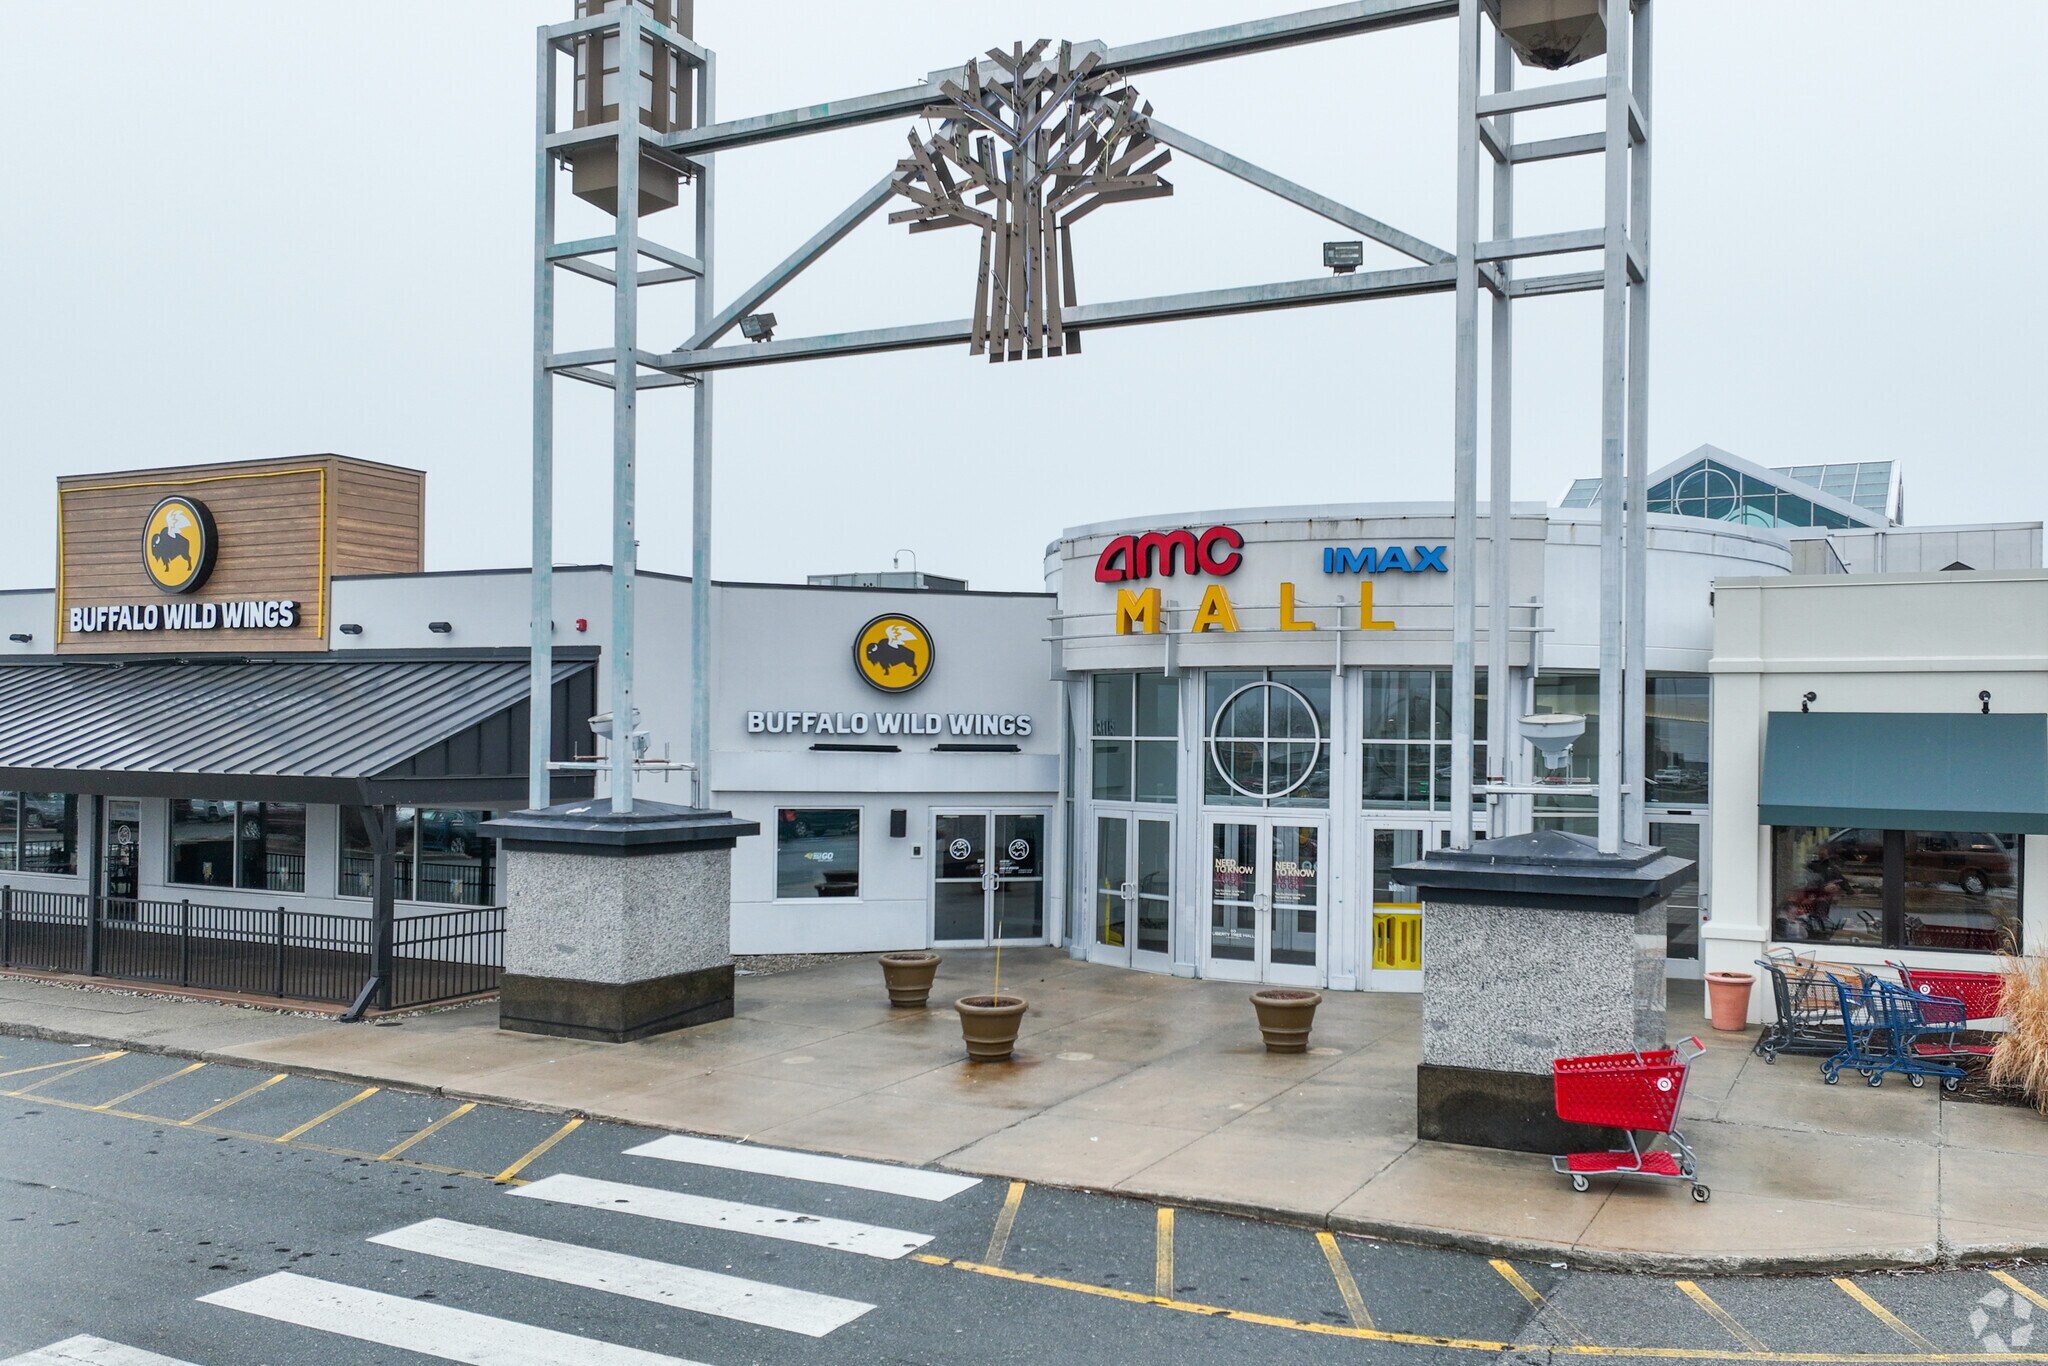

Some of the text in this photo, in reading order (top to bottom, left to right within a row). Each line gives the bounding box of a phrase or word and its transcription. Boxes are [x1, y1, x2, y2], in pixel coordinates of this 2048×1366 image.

[1094, 525, 1449, 583] AMC IMAX
[69, 600, 298, 633] BUFFALO WILD WINGS
[1115, 581, 1396, 635] MALL
[747, 711, 1033, 737] BUFFALO WILD WINGS
[1215, 858, 1236, 867] NEED
[1215, 866, 1254, 875] TO KNOW
[1275, 861, 1297, 870] NEED
[1276, 869, 1315, 878] TO KNOW
